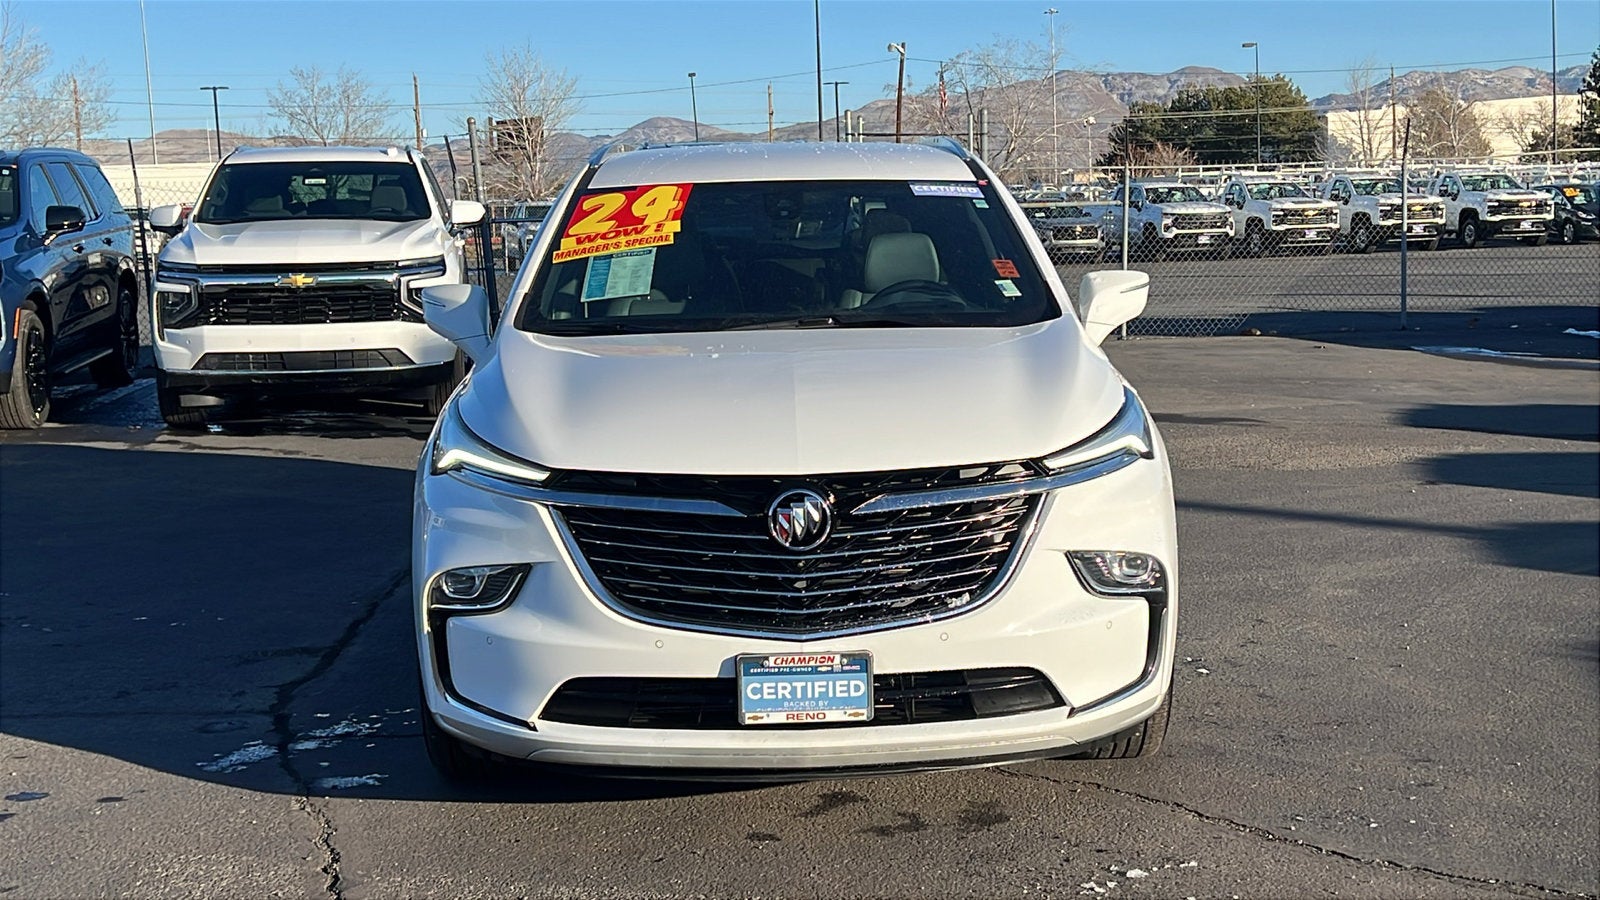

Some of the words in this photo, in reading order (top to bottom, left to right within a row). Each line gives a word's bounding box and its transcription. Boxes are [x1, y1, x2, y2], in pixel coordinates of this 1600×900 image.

[914, 185, 978, 194] CERTIFIED
[568, 185, 683, 236] 24
[554, 241, 622, 260] MANAGER'S
[624, 234, 671, 249] SPECIAL
[773, 655, 836, 666] CHAMPION
[746, 680, 866, 700] CERTIFIED
[783, 700, 816, 708] BACKED
[786, 712, 827, 721] RENO
